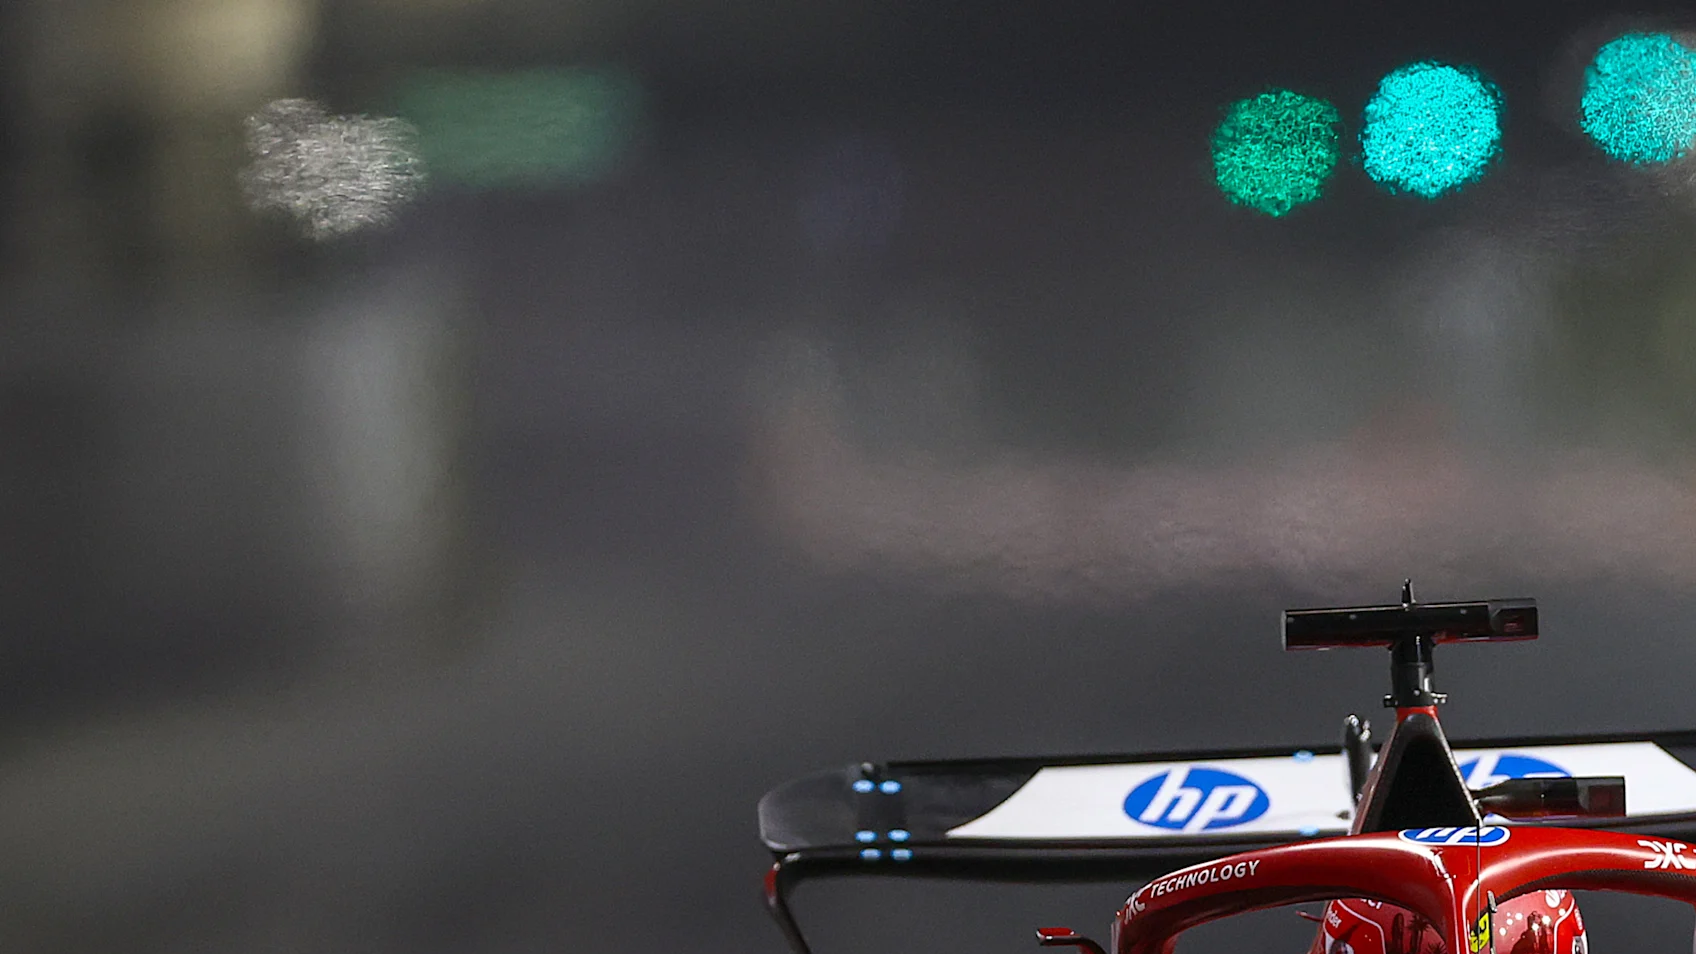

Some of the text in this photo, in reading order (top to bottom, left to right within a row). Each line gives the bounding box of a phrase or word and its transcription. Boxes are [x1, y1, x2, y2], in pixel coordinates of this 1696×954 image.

[1138, 765, 1259, 832] hp
[1637, 839, 1696, 870] DXC
[1150, 859, 1260, 898] TECHNOLOGY
